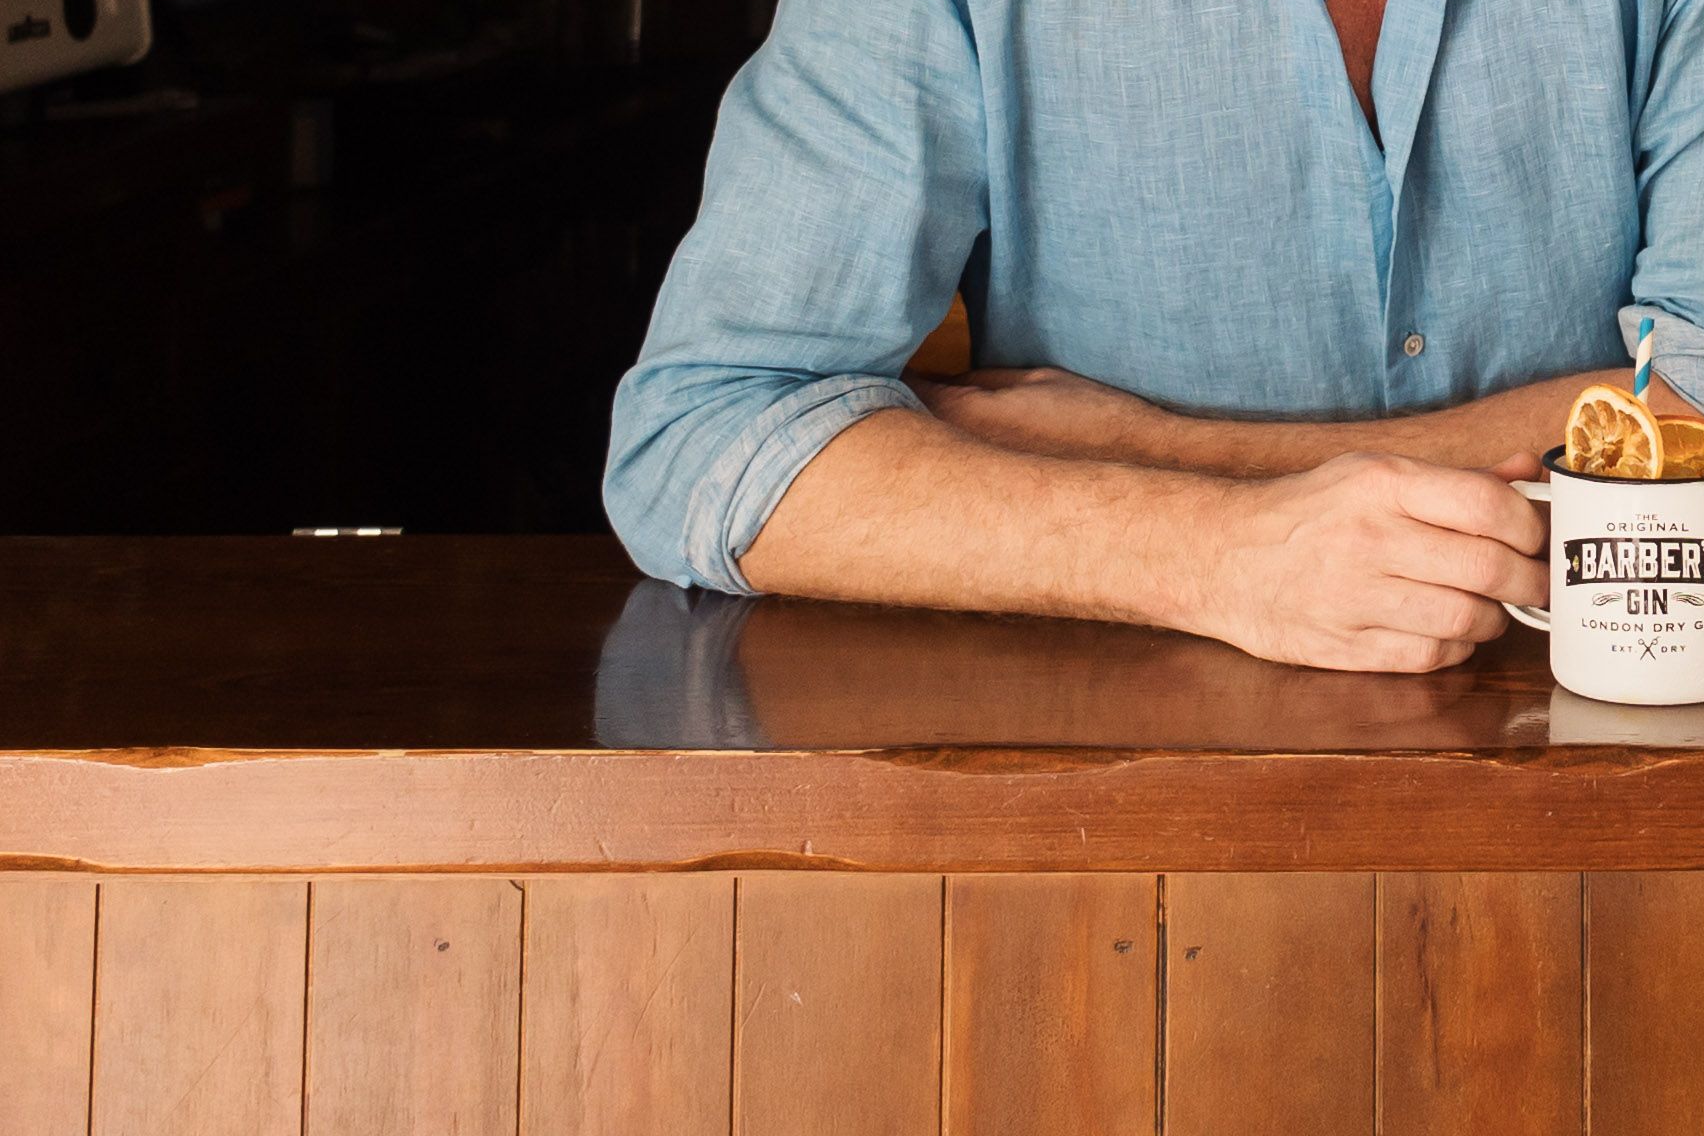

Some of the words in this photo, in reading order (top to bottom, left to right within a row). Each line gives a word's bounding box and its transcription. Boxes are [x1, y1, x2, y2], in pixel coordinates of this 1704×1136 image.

[1635, 513, 1659, 521] THE
[1606, 522, 1690, 532] ORIGINAL
[1626, 588, 1668, 615] GIN
[1581, 617, 1644, 633] LONDON
[1653, 622, 1686, 633] DRY
[1660, 644, 1686, 653] DRY
